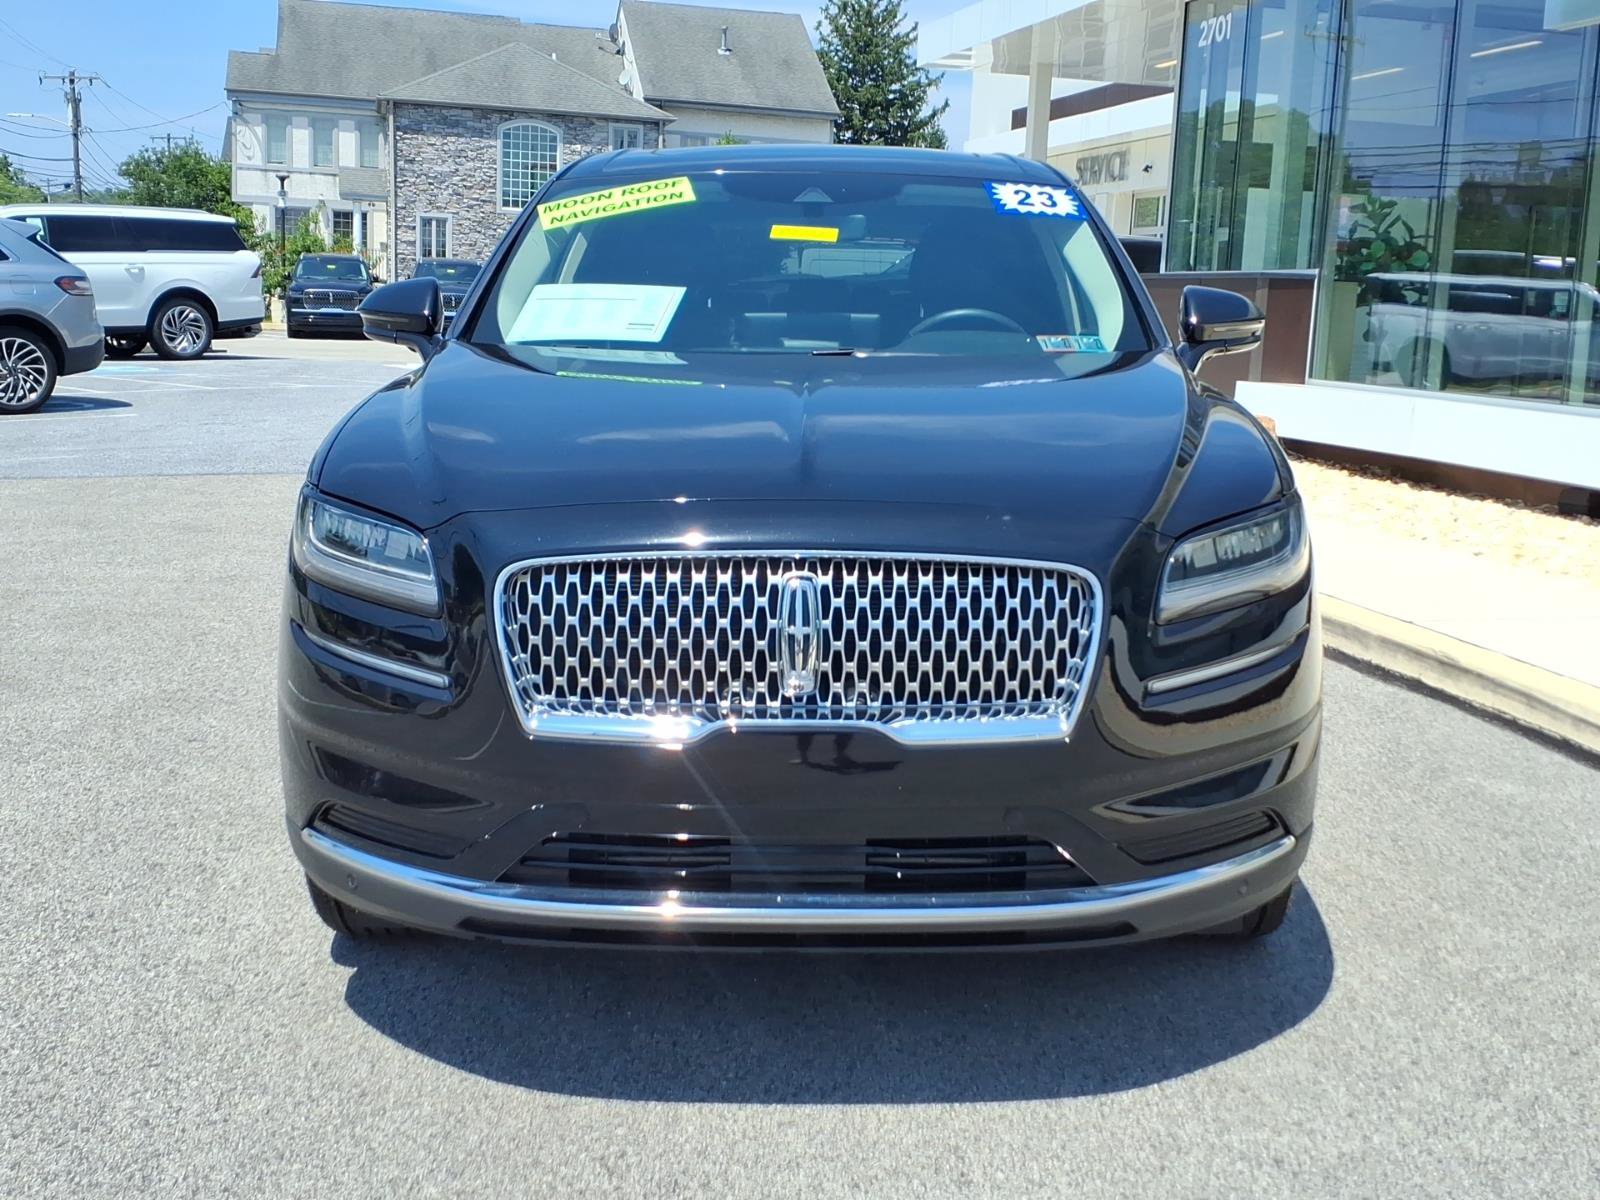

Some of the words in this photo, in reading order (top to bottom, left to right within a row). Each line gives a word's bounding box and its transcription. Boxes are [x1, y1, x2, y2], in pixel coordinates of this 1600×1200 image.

[1198, 12, 1232, 47] 2701
[543, 191, 613, 214] MOON
[622, 179, 684, 197] ROOF
[550, 191, 684, 225] NAVIGATION
[1013, 189, 1058, 208] 23
